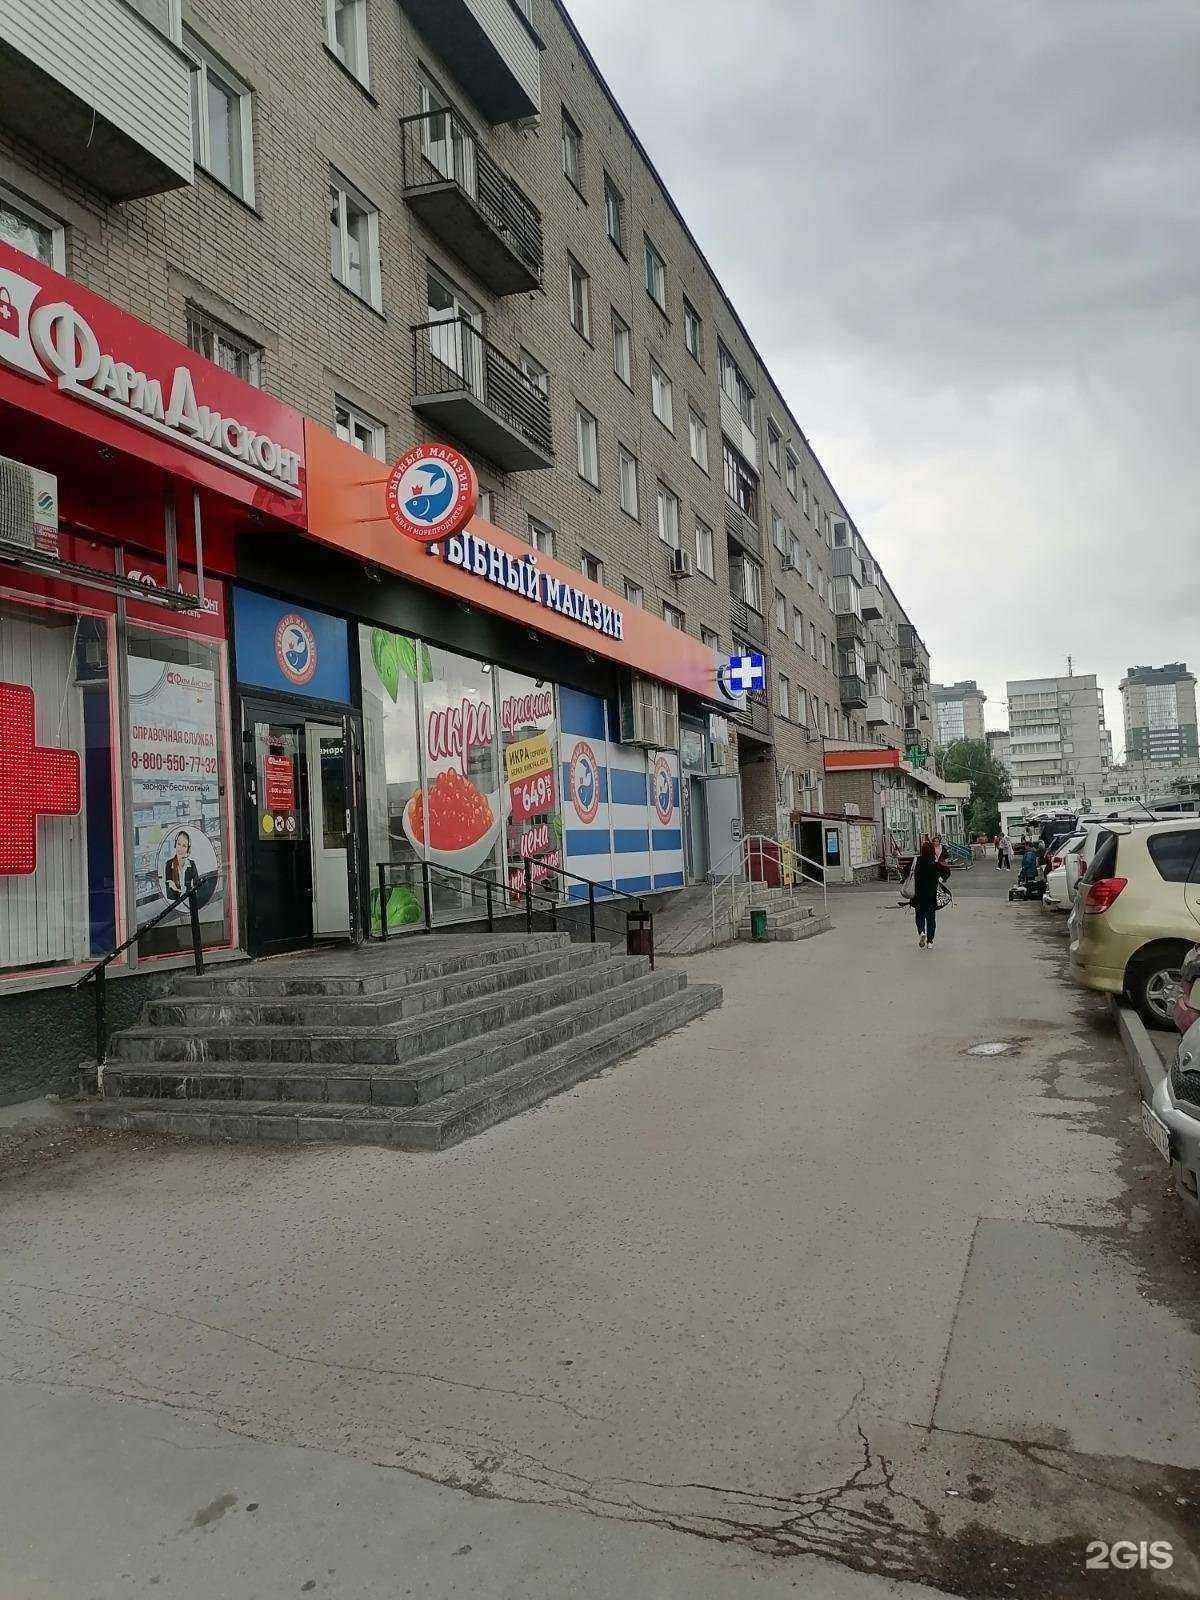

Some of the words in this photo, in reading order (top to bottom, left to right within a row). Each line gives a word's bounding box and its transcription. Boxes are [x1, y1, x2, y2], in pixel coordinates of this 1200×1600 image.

[389, 447, 424, 498] РЫБНЫЙ
[429, 447, 468, 491] МАГАЗИН
[427, 530, 541, 603] ЫБНЫЙ
[546, 574, 624, 641] МАГАЗИН
[132, 725, 183, 744] СПРАВОЧНАЯ
[184, 731, 215, 747] СЛУЖБА
[427, 698, 493, 775] икра
[502, 690, 552, 735] красная
[131, 751, 217, 774] 8-800-550-77-32
[508, 747, 530, 766] ИКРА
[522, 777, 546, 812] 649
